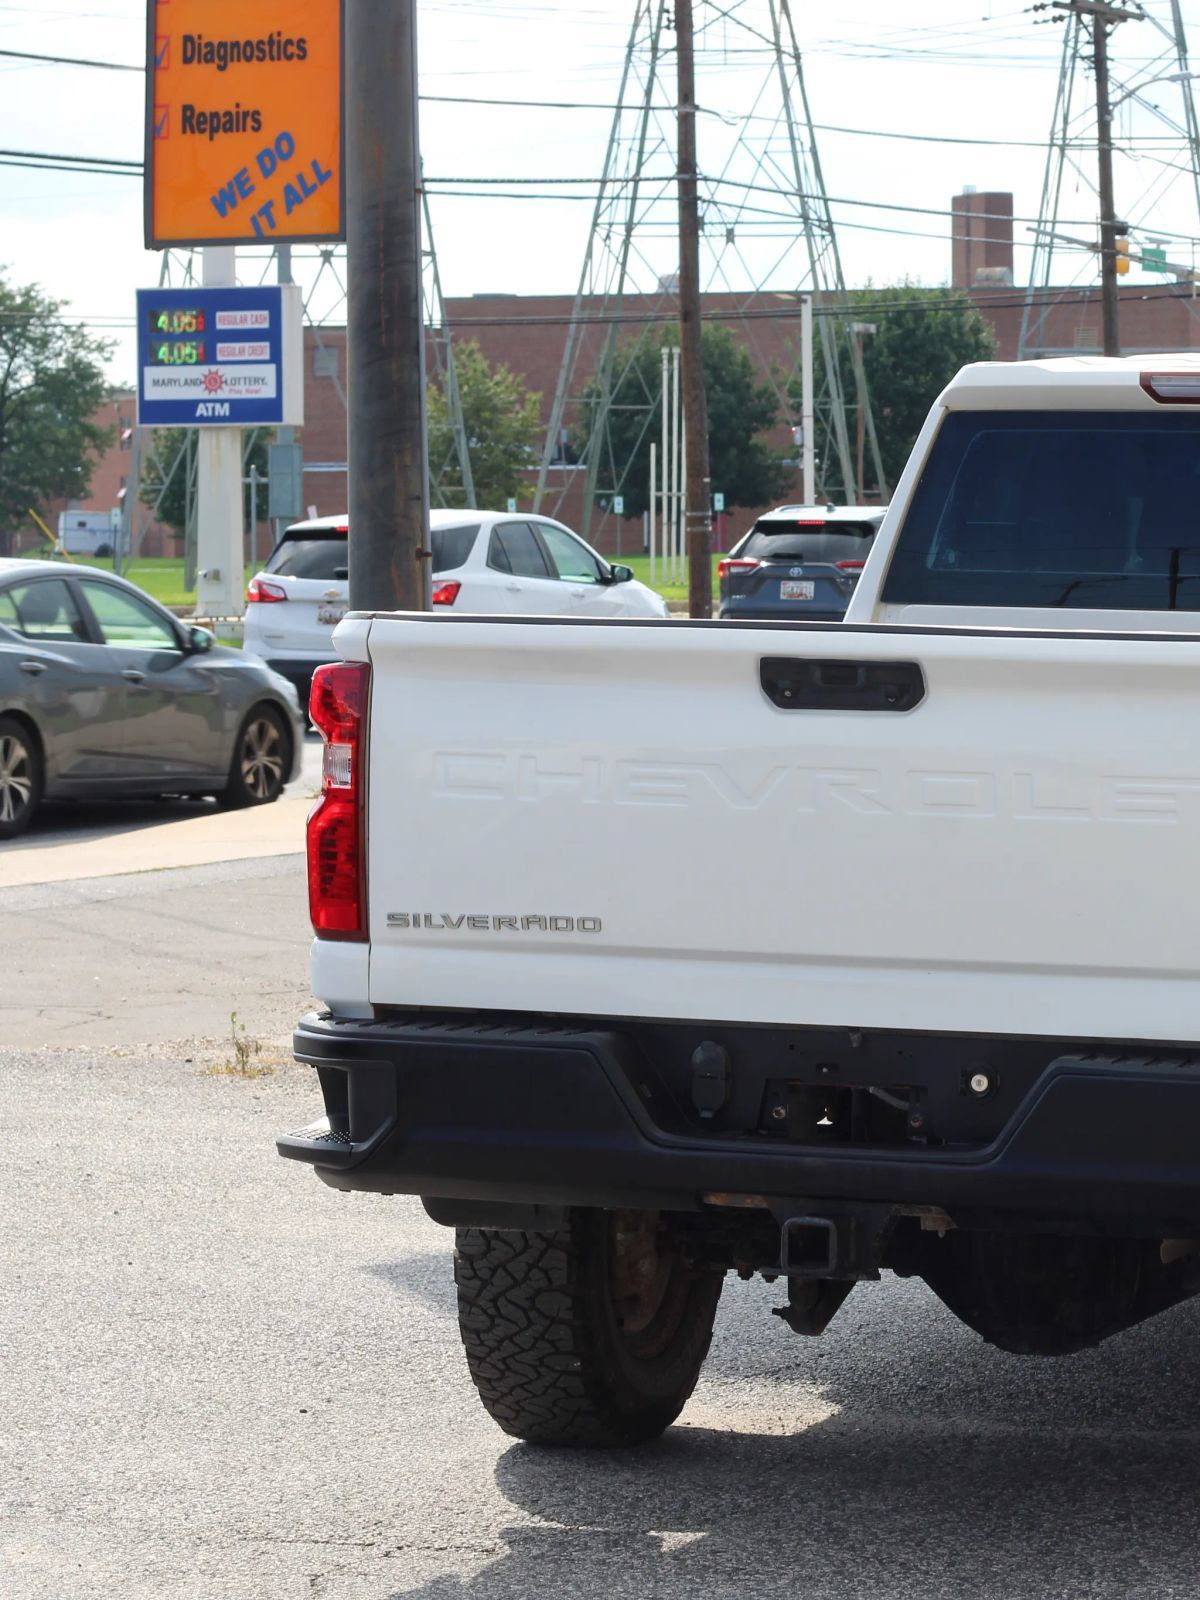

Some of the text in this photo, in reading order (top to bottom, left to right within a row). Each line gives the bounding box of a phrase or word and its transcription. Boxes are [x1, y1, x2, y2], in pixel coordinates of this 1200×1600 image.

[181, 32, 308, 72] Diagnostics
[181, 103, 262, 142] Repairs
[210, 131, 296, 219] WE DO
[249, 159, 333, 237] IT ALL
[152, 377, 202, 388] MARYLAND
[195, 402, 230, 417] ATM
[386, 912, 602, 933] SILVERADO
